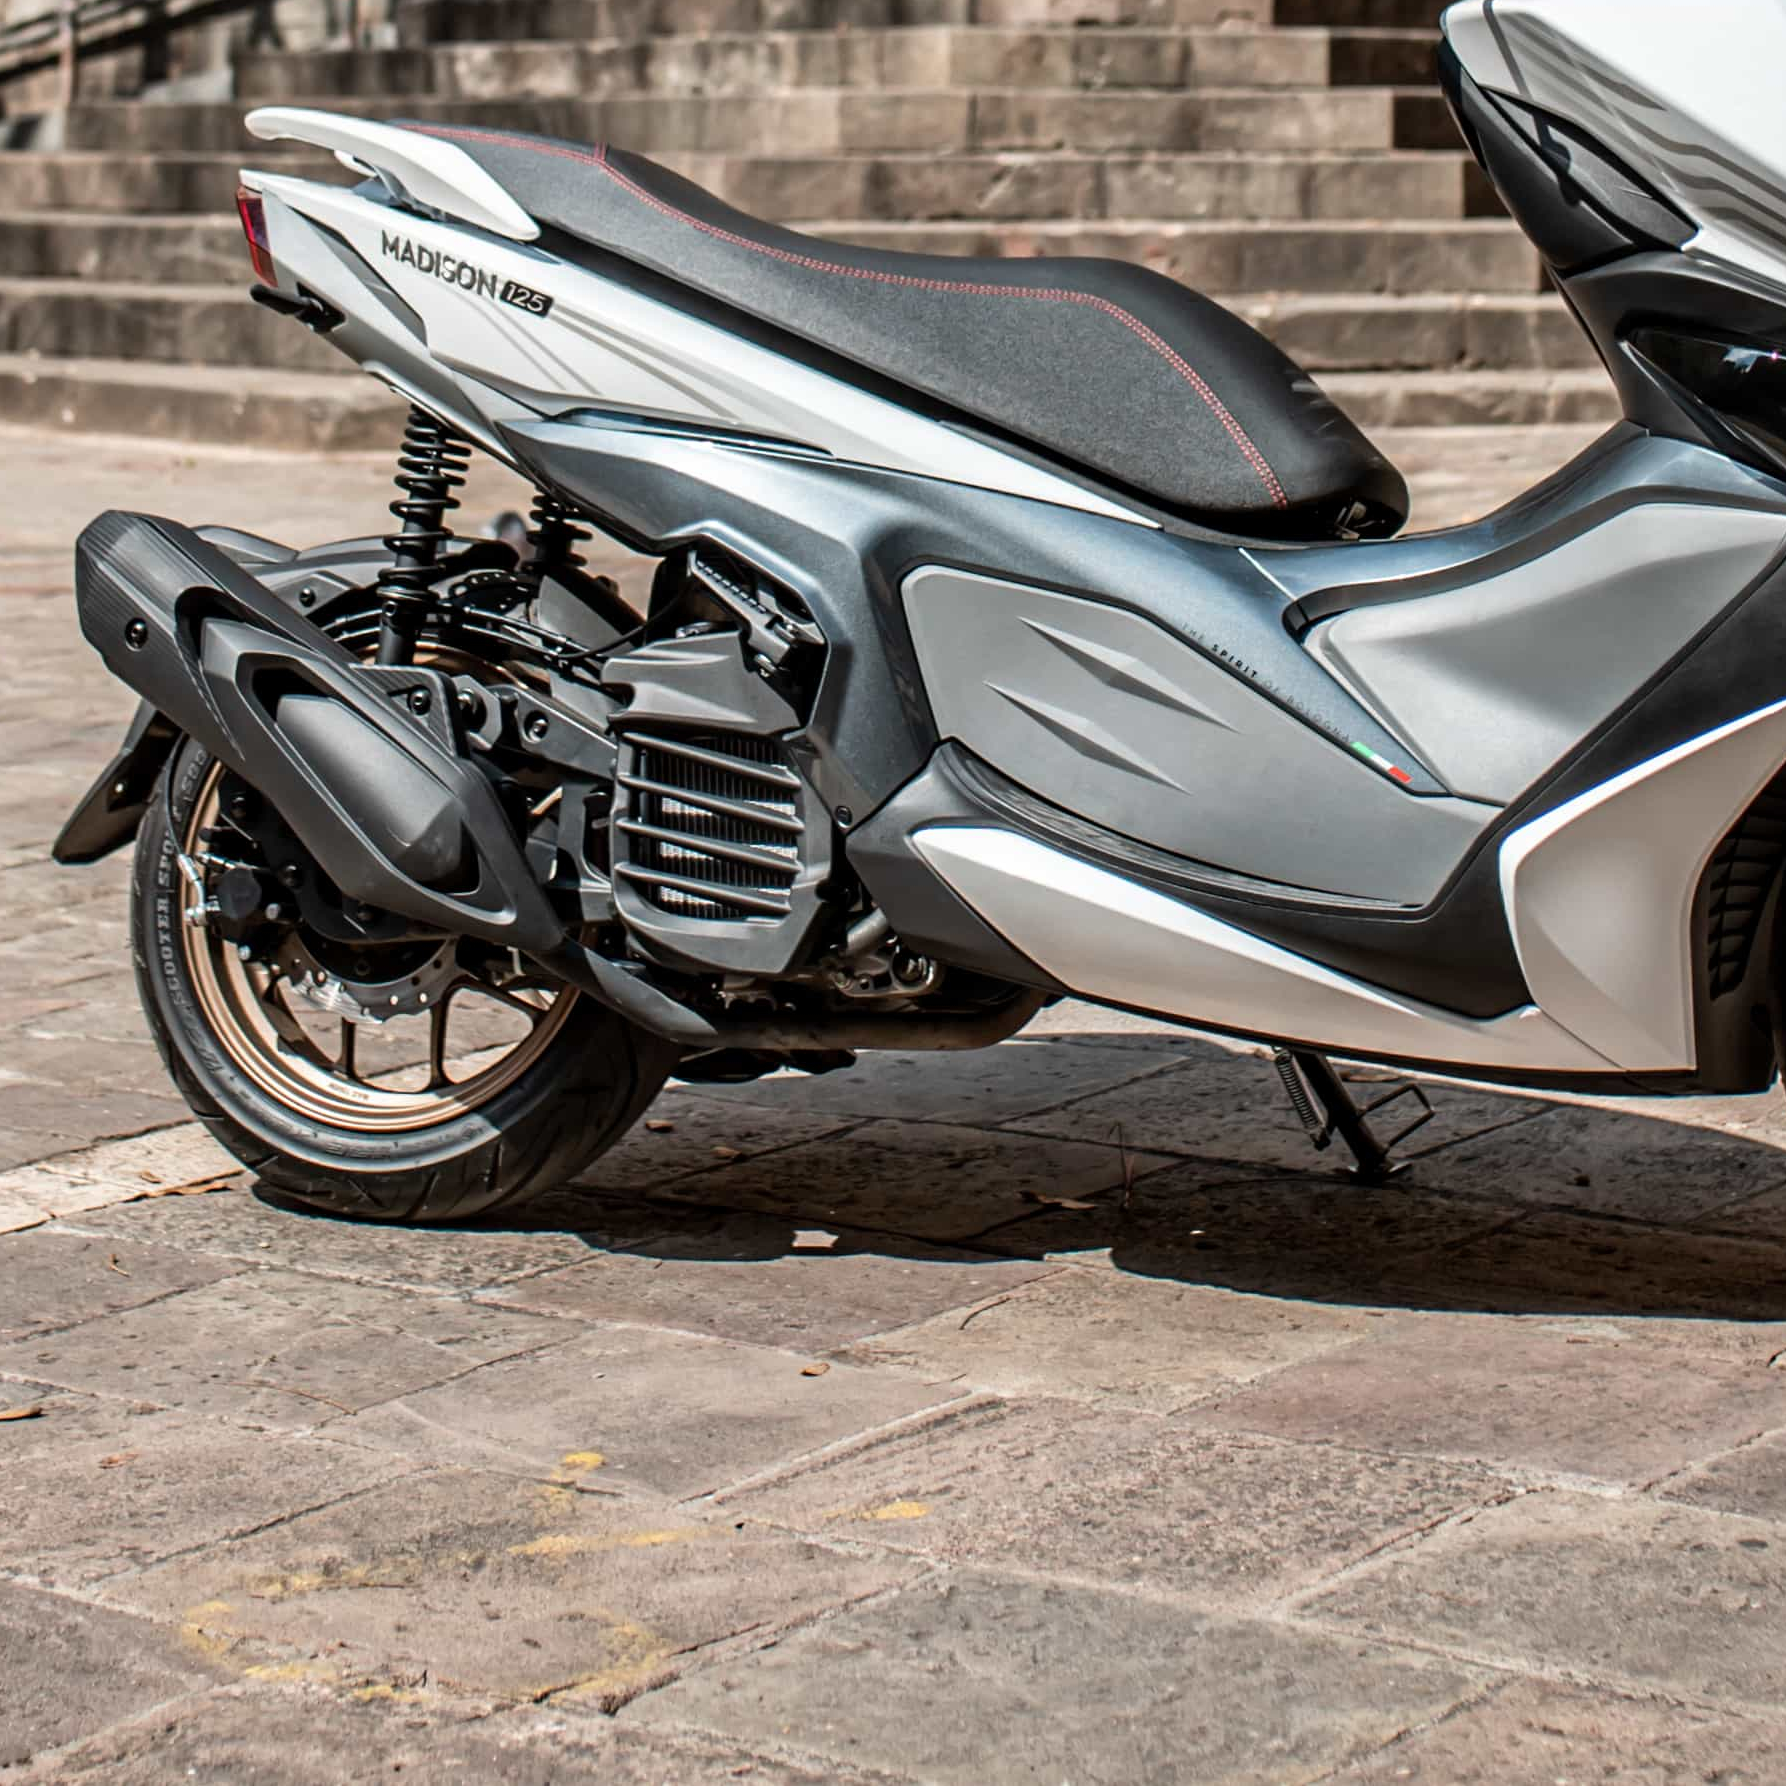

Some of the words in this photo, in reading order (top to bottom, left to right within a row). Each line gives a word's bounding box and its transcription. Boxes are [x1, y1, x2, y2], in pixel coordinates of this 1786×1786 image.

[381, 229, 498, 300] MADISON
[505, 283, 548, 313] 125
[1181, 622, 1205, 640] THE
[1211, 643, 1258, 679] SPIRIT
[1286, 695, 1350, 743] BOLOGNA
